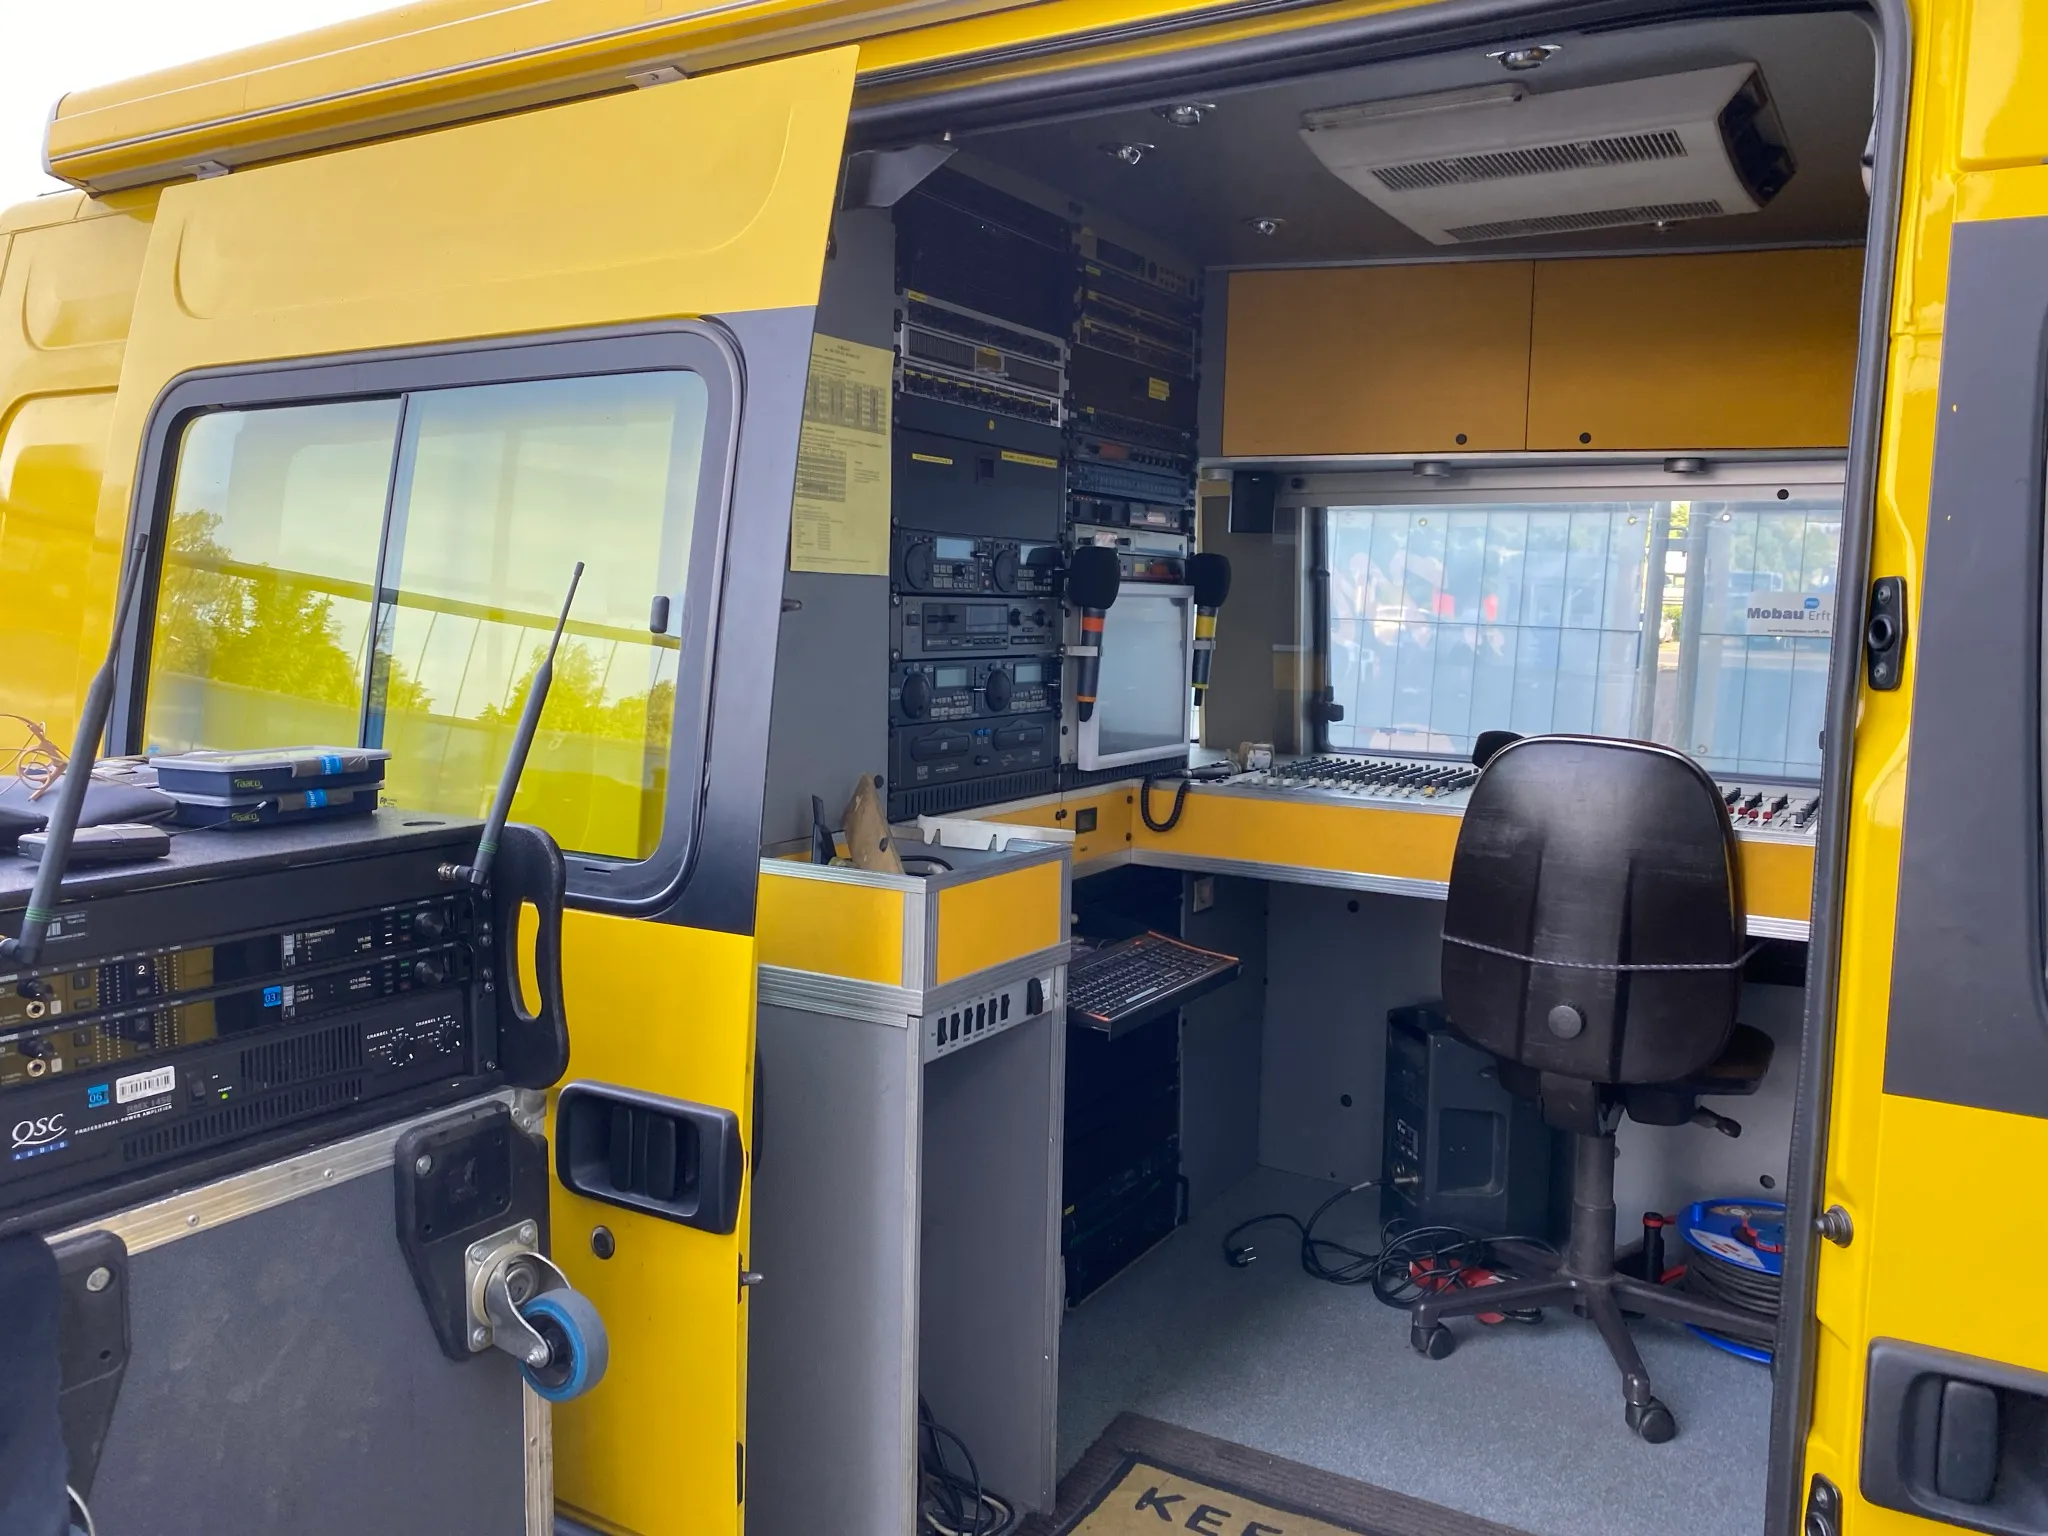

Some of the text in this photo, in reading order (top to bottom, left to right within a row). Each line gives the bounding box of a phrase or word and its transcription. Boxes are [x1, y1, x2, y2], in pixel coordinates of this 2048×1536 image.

[1747, 607, 1832, 621] Mobau Erft
[138, 965, 146, 975] 2
[89, 1092, 103, 1102] 06
[75, 1104, 173, 1135] PROFESSIONAL POWER AMPLIFIER
[12, 1113, 67, 1149] QSC
[15, 1141, 66, 1160] AUDIO
